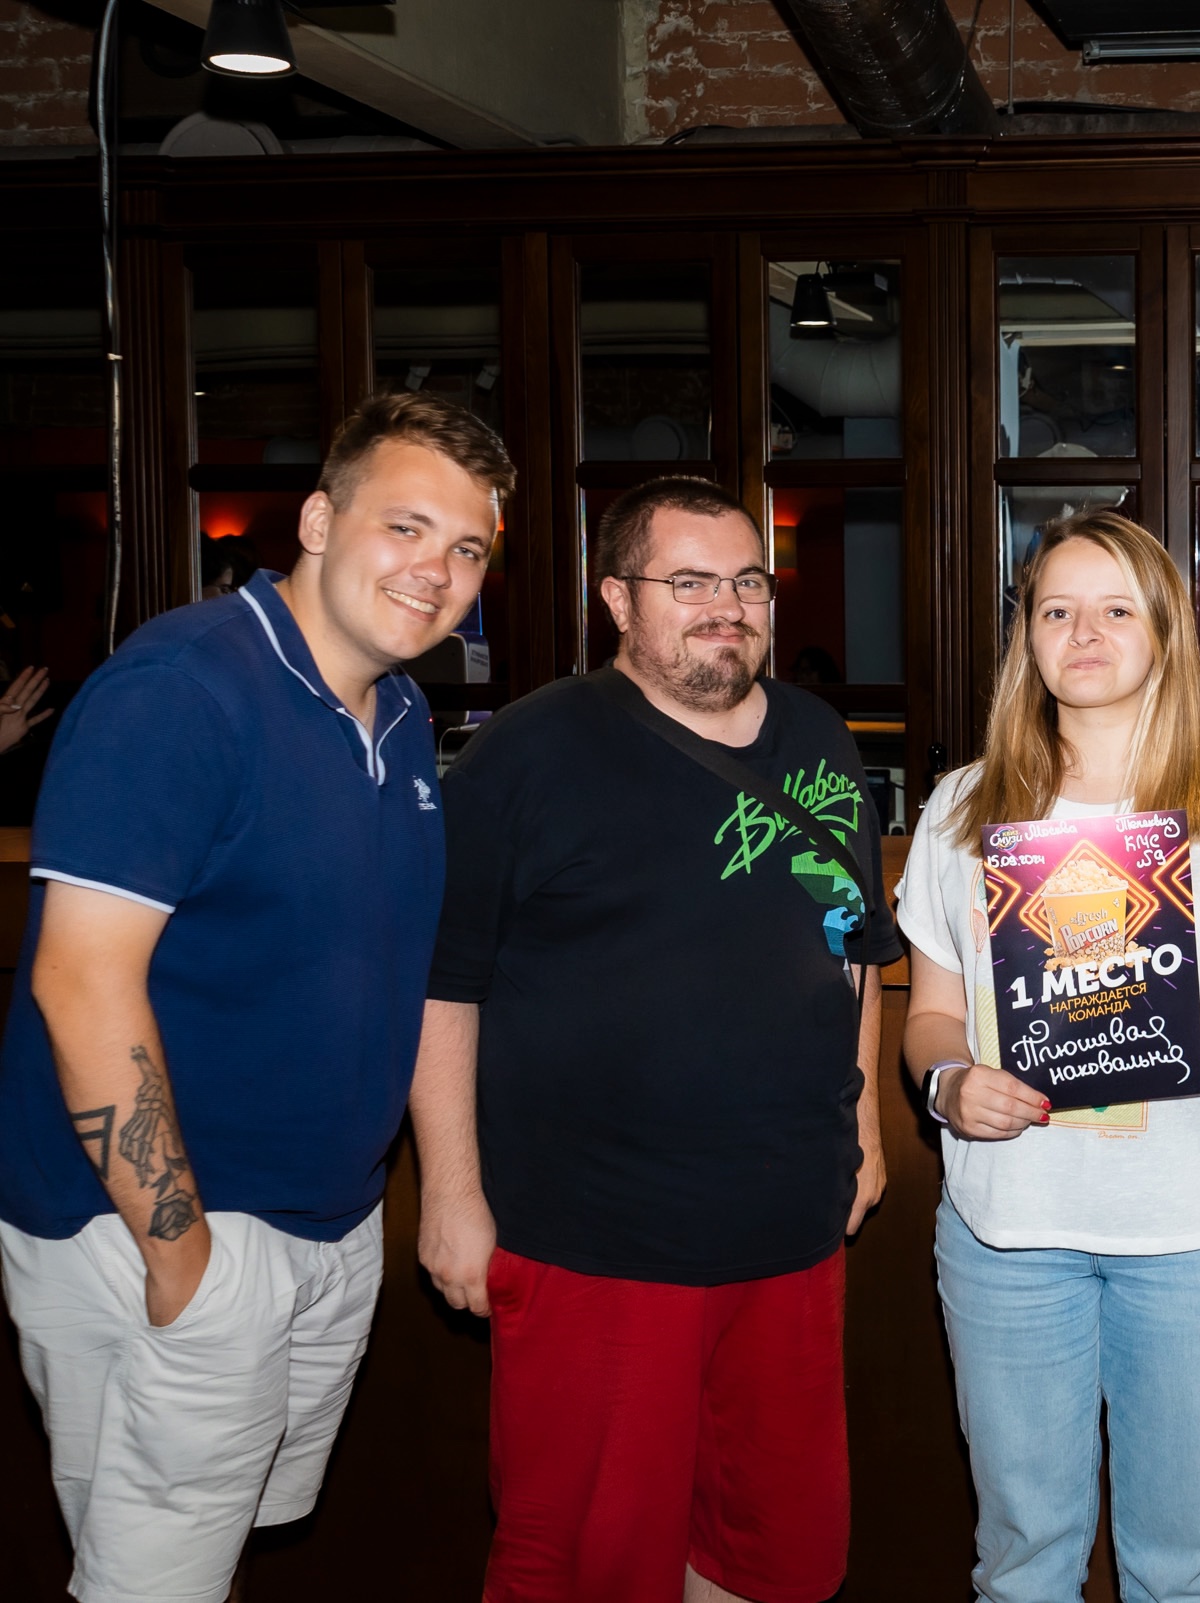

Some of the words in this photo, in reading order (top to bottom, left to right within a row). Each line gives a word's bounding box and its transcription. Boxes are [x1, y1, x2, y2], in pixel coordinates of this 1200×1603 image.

[990, 833, 1023, 847] Смузи
[1024, 820, 1078, 841] Москва
[1011, 976, 1033, 1009] 1
[1041, 943, 1183, 1004] МЕСТО
[1050, 982, 1147, 1014] НАГРАЖДАЕТСЯ
[1068, 999, 1131, 1023] КОМАНДА
